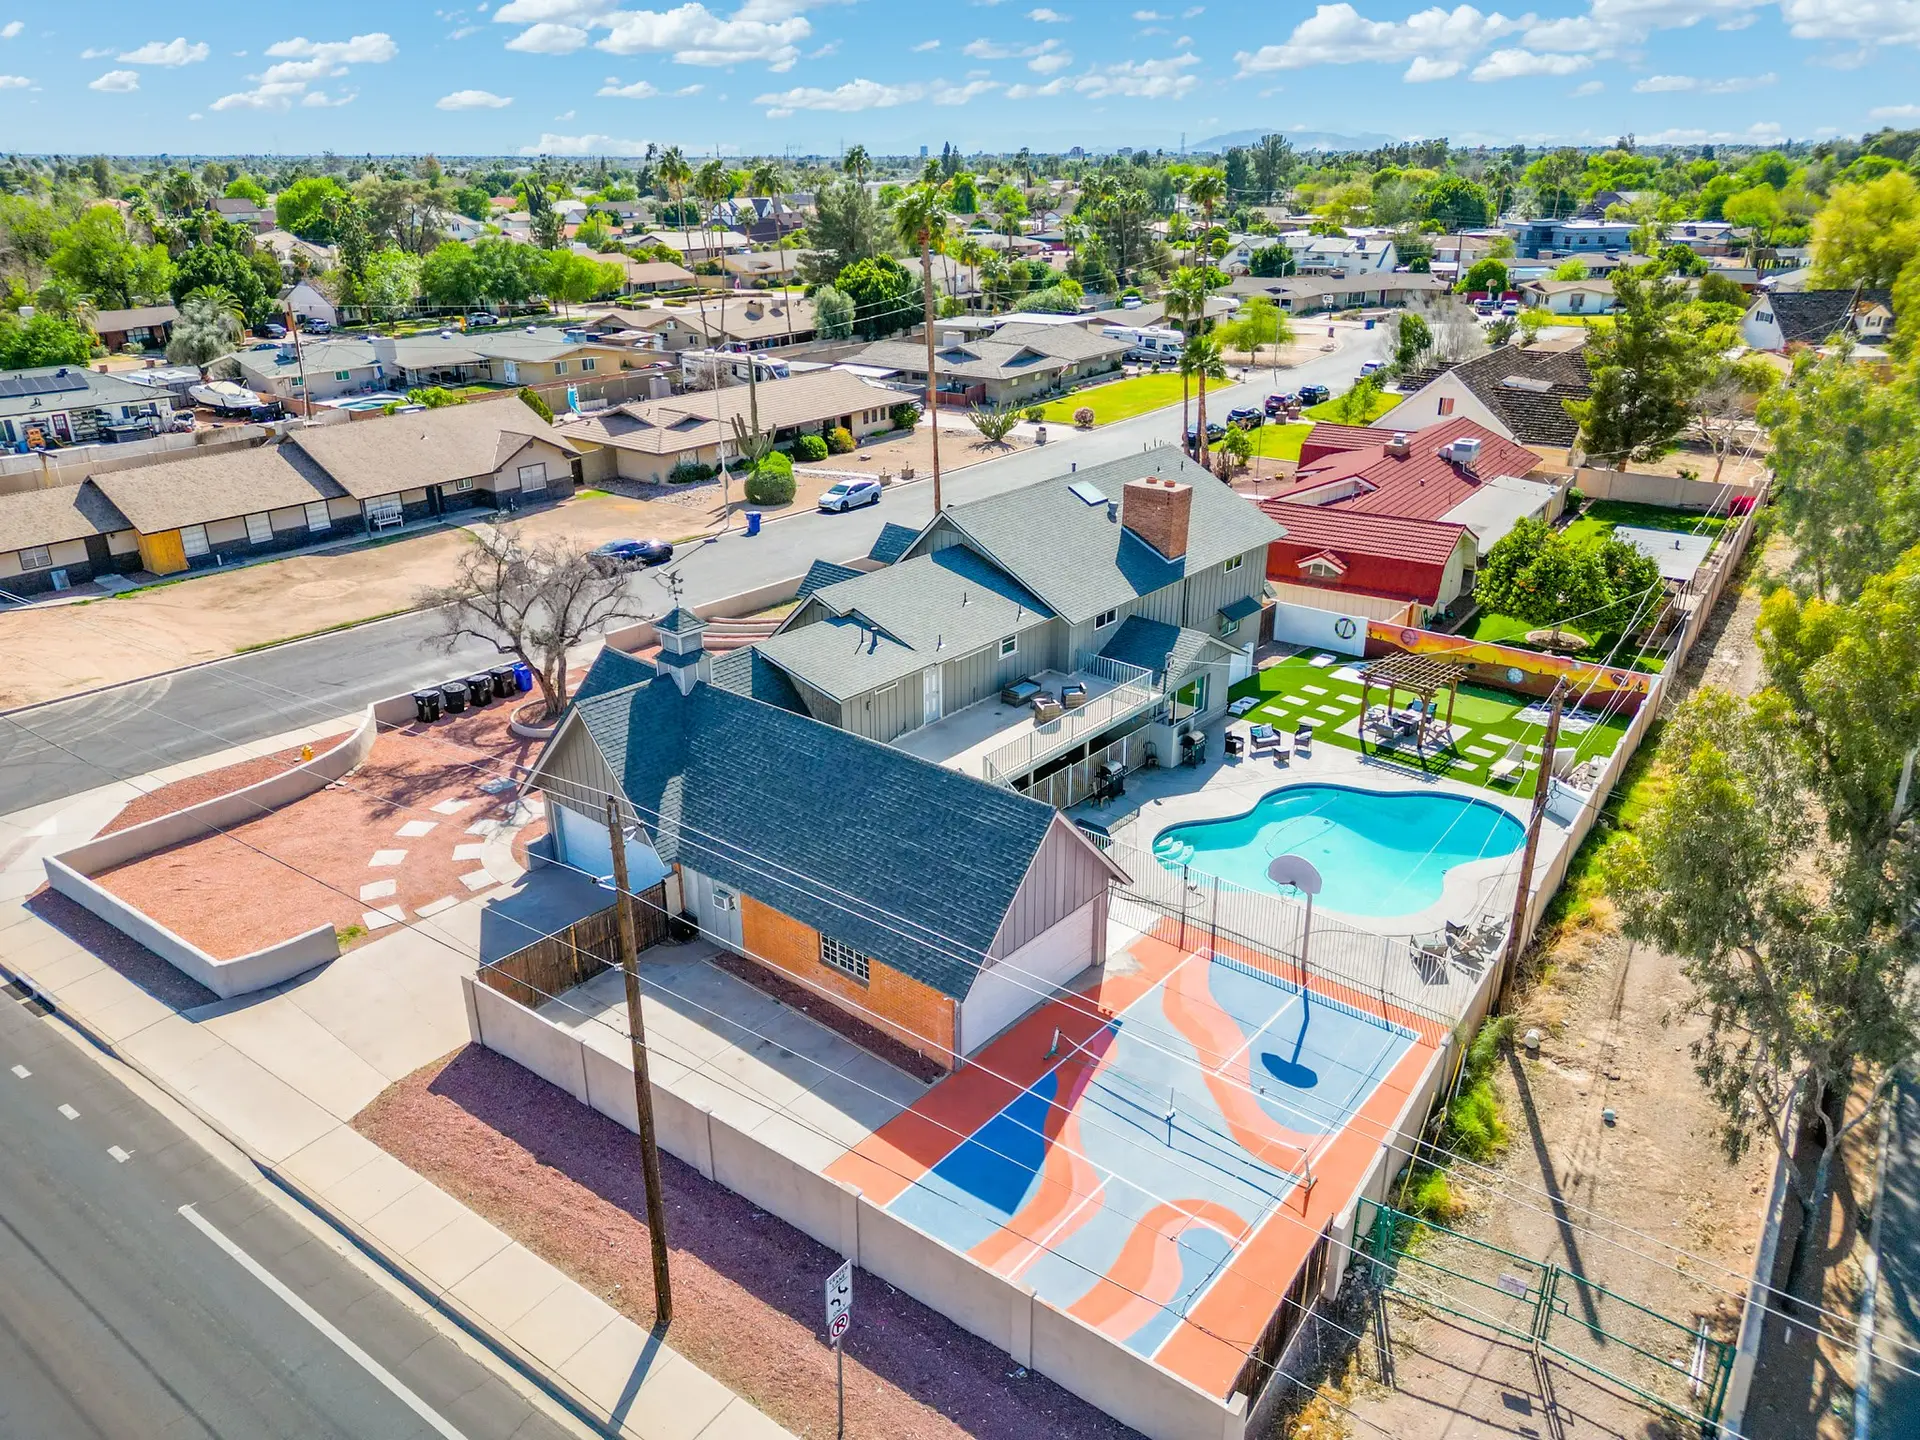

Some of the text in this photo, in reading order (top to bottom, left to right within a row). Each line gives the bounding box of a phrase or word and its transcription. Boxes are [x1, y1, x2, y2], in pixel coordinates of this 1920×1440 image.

[829, 1265, 848, 1285] CENTER
[832, 1273, 845, 1288] LANE
[832, 1302, 847, 1317] ONLY
